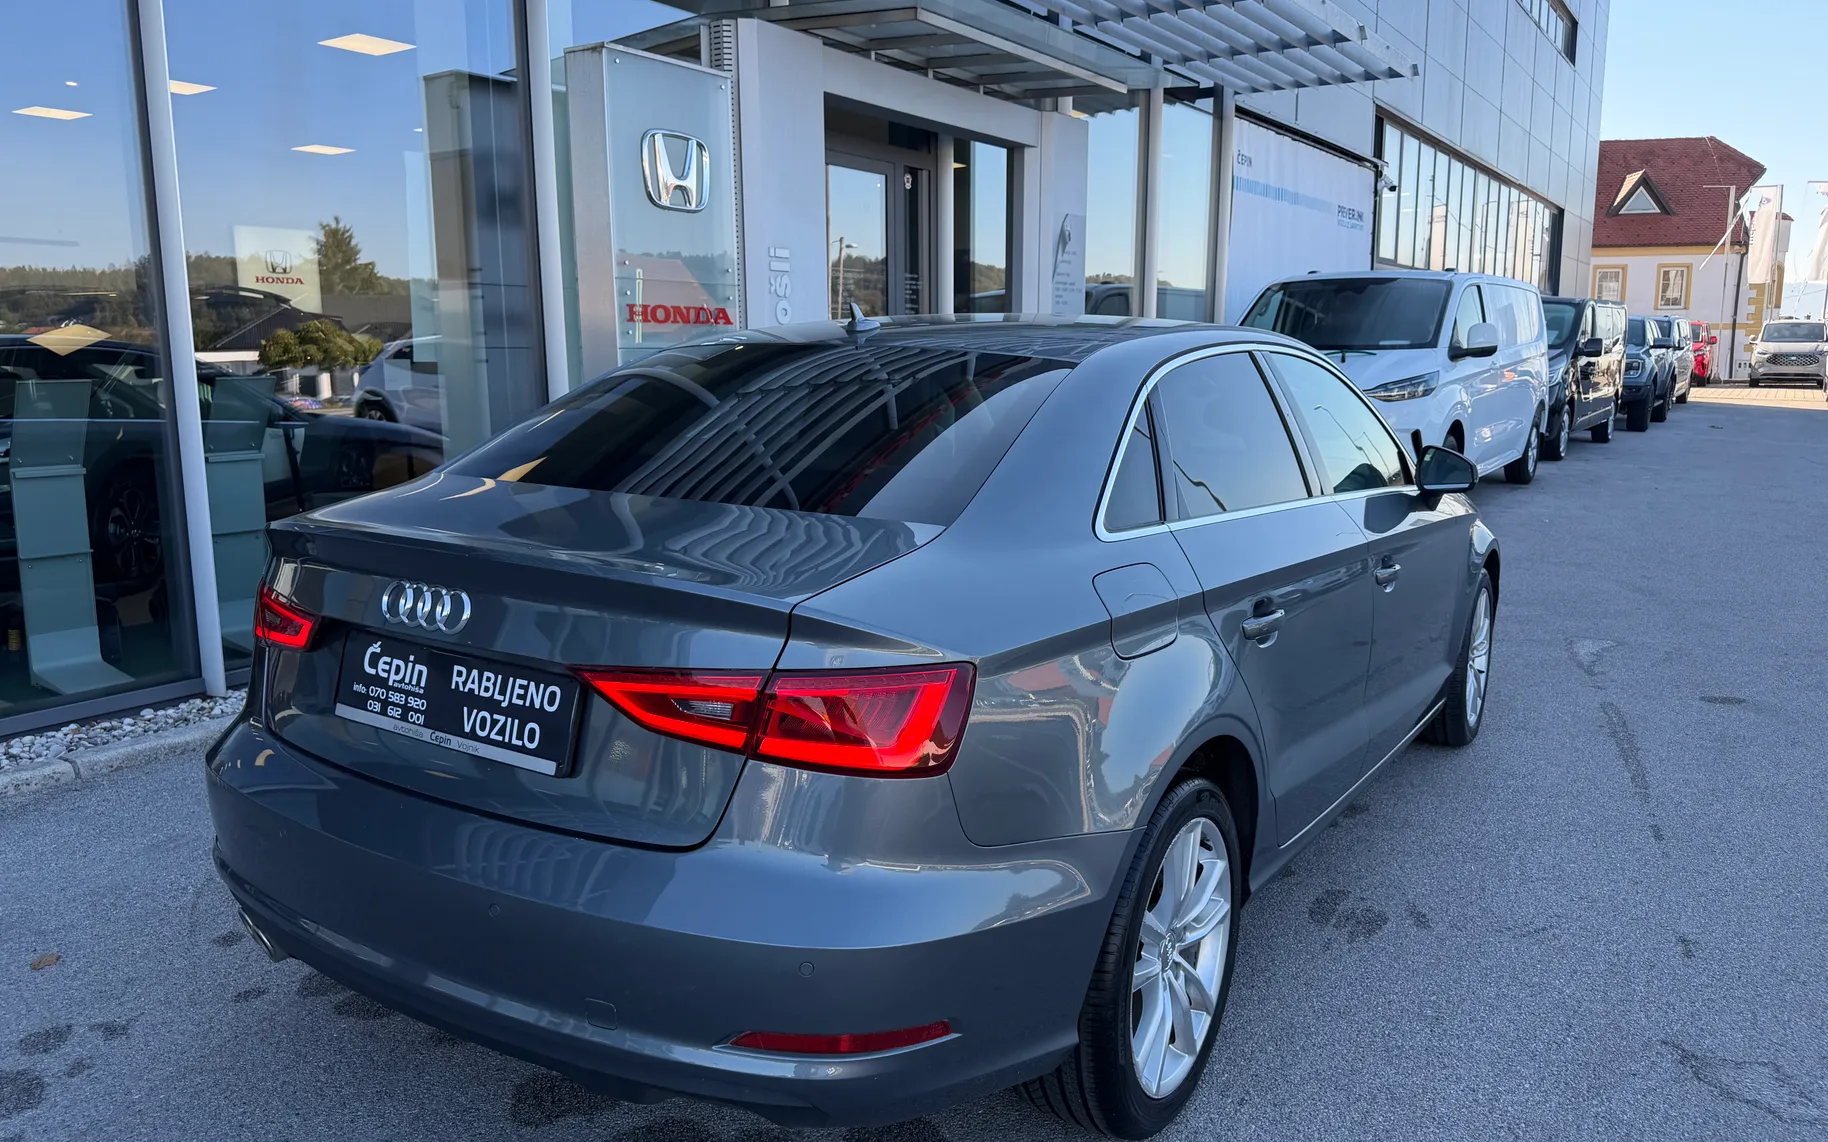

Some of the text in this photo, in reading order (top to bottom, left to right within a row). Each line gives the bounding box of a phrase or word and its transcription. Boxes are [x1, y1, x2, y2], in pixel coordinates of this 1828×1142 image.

[255, 276, 305, 285] HONDA
[626, 303, 734, 326] HONDA
[363, 641, 428, 688] Čepin
[353, 682, 427, 711] info: 070 583 920
[393, 681, 424, 694] avtohiša
[451, 665, 561, 713] RABLJENO
[367, 699, 425, 725] 031 612 001
[392, 724, 480, 754] avtohiša Čepin Vojnik
[463, 706, 540, 750] VOZILO
